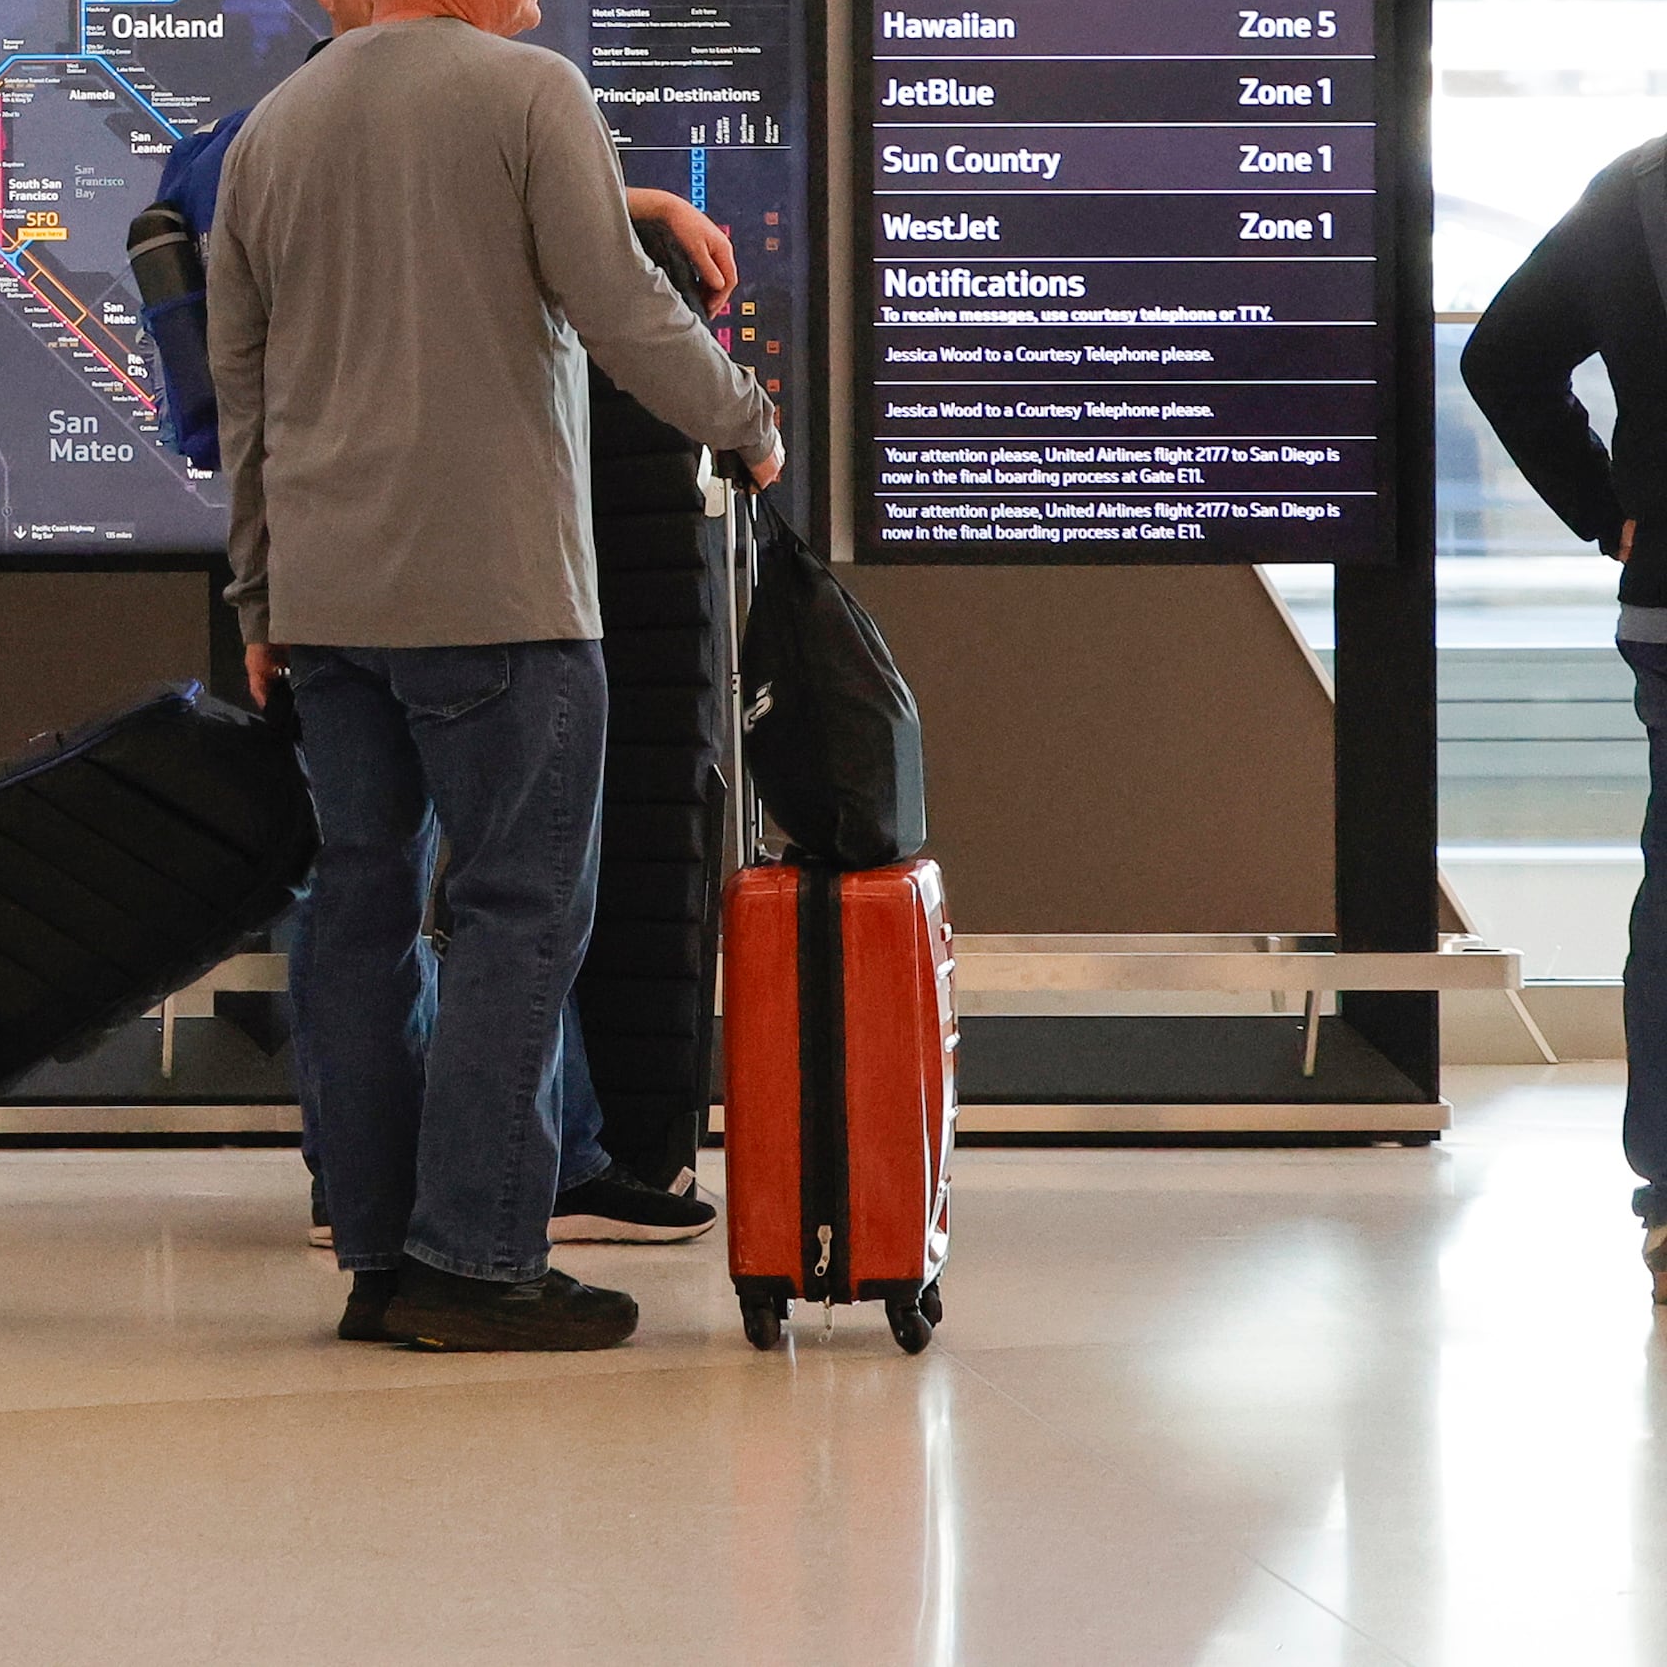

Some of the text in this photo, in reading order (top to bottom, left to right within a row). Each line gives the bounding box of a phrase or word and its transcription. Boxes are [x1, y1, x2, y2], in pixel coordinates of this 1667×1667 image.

[111, 13, 224, 39] Oakland
[881, 77, 1332, 106] JetBlue Zone 1
[882, 145, 1332, 180] Sun Country Zone 1
[26, 211, 59, 227] SFO
[882, 212, 1332, 241] WestJet Zone 1
[884, 267, 1086, 298] Notifications
[884, 345, 1215, 365] Jessica Wood to a Courtesy Telephone please.
[48, 409, 98, 434] San
[50, 438, 134, 462] Mateo
